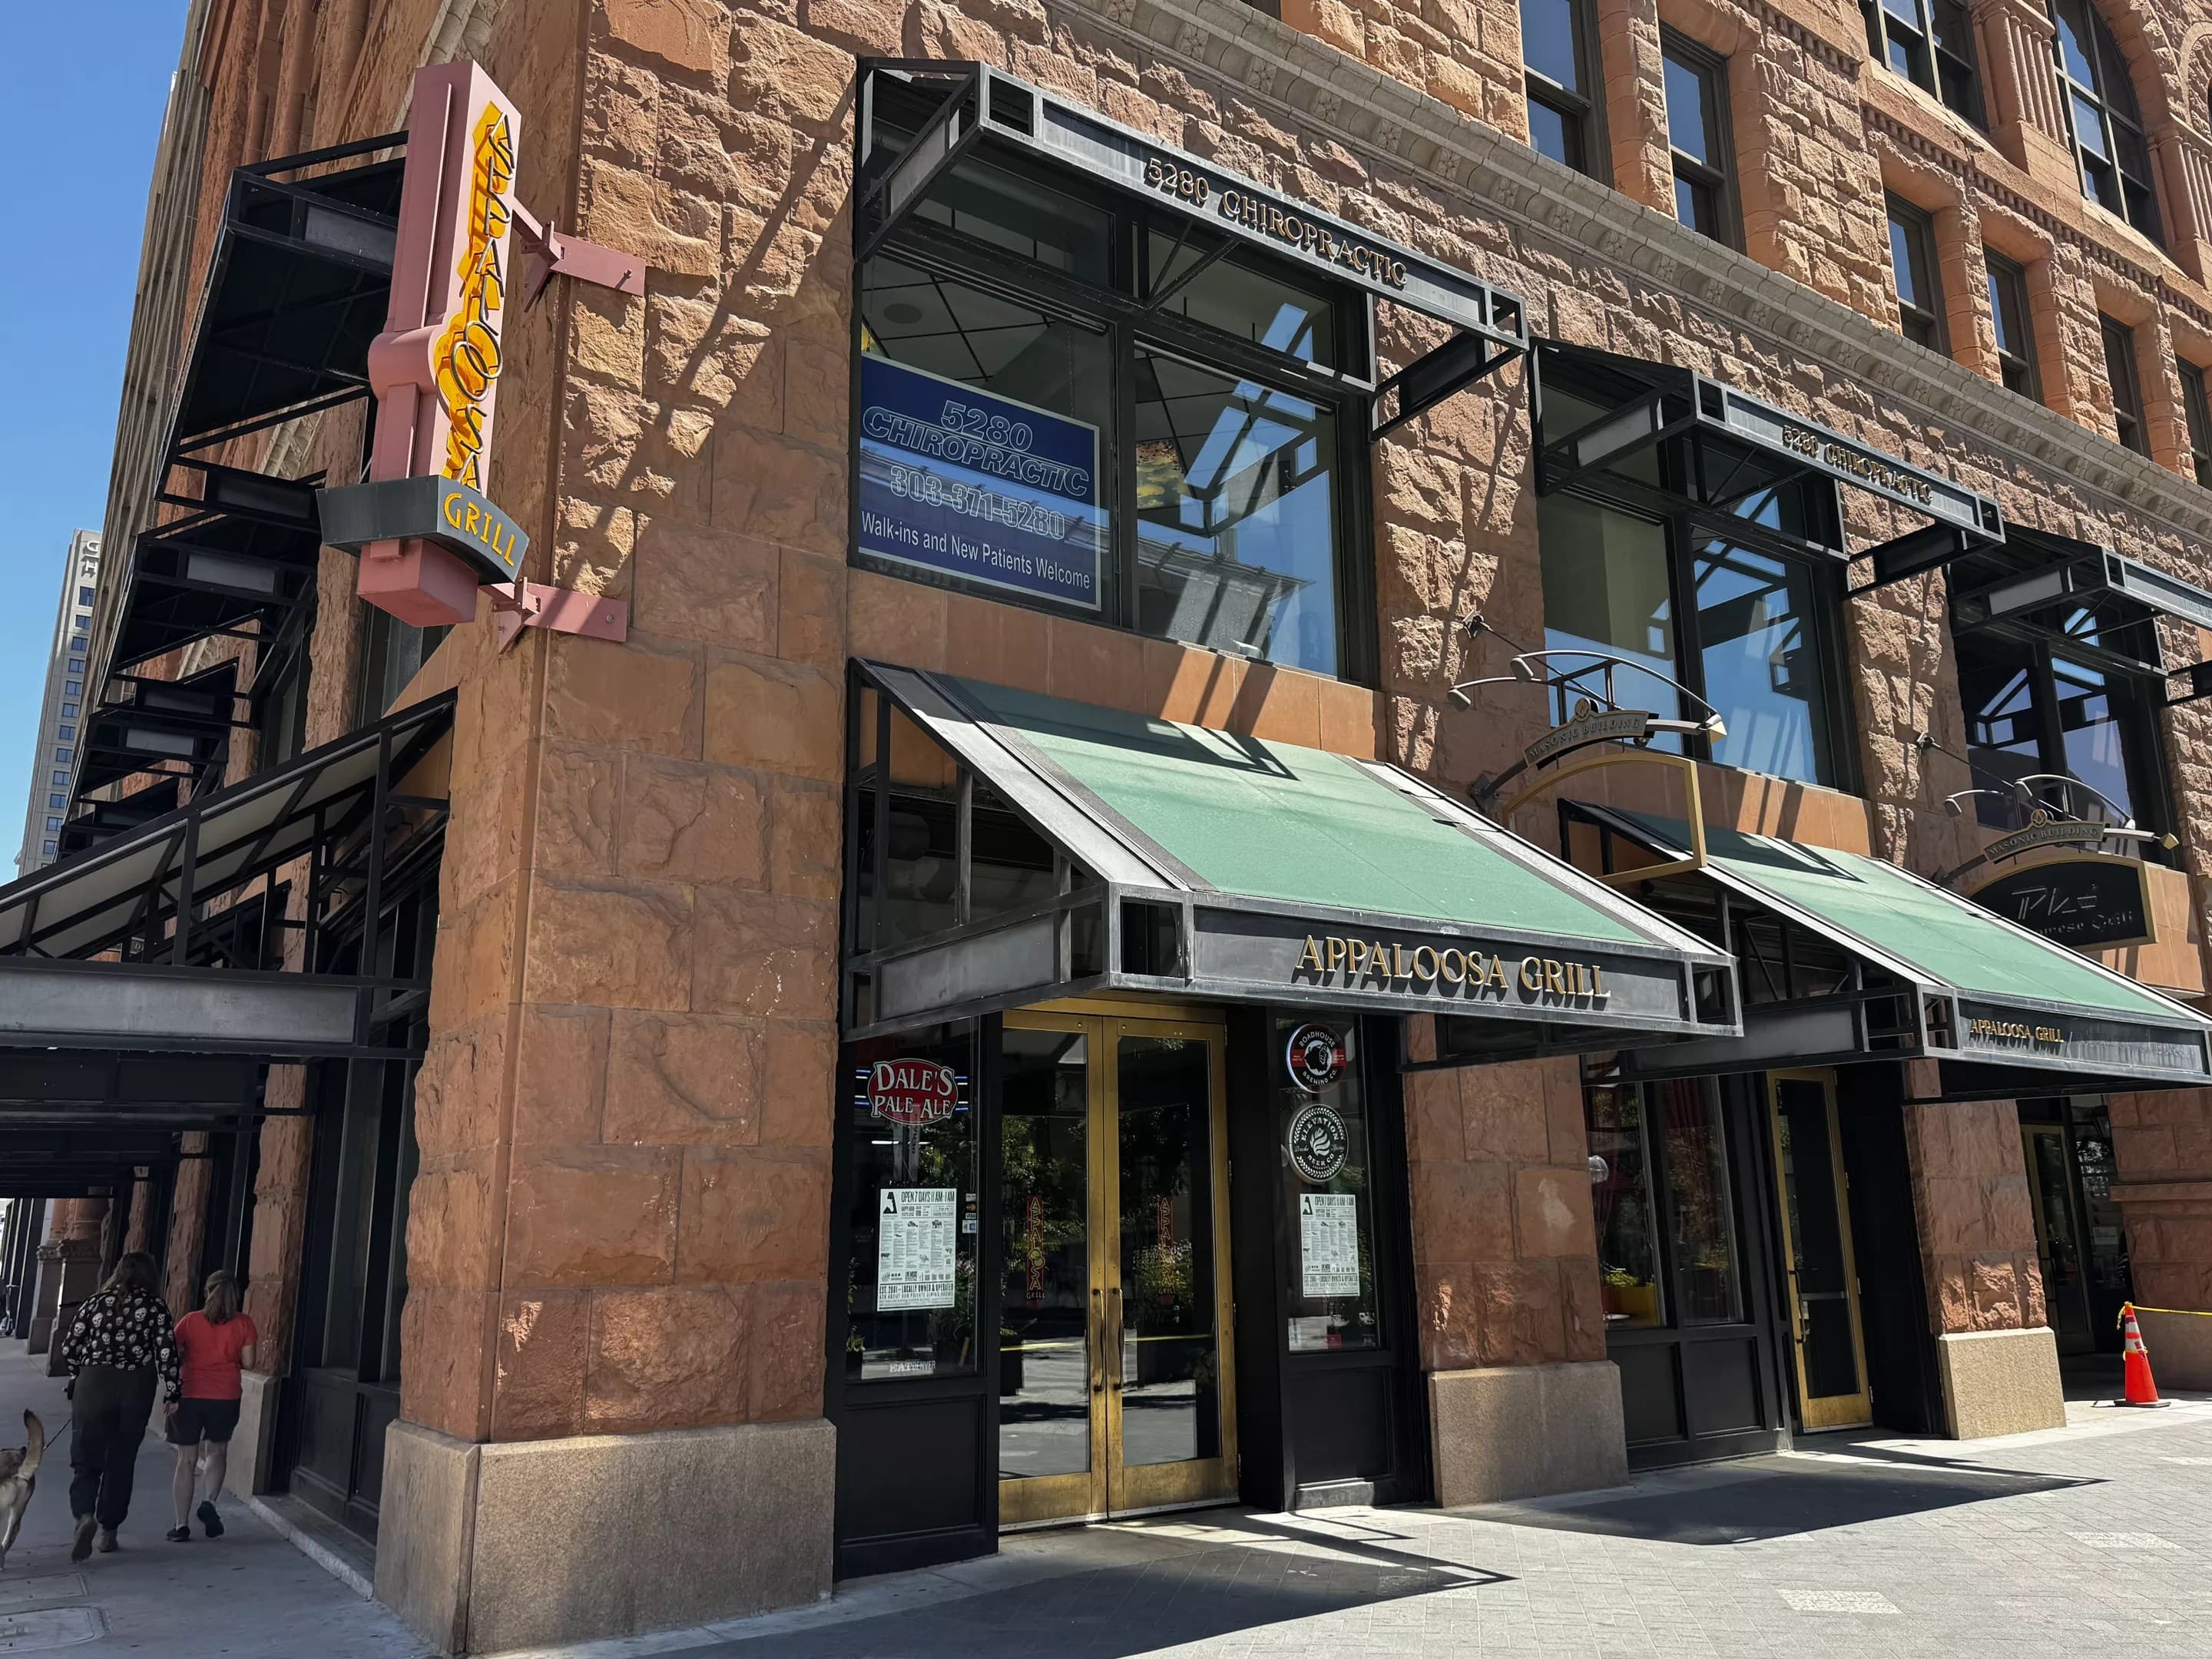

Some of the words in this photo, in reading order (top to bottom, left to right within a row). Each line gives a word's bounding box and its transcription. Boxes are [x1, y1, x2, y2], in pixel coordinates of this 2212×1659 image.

[1147, 157, 1210, 205] 5280
[1222, 189, 1408, 287] CHIROPRACTIC
[435, 101, 513, 493] APPALOOSA
[863, 406, 1089, 497] CHIROPRACTIC
[941, 400, 1033, 452] 5280
[1783, 424, 1820, 456] 5280
[1824, 443, 1933, 503] CHIROPRACTIC
[890, 465, 1065, 540] 303-371-5280
[444, 492, 515, 567] GRILL
[862, 511, 919, 545] Walk-ins
[922, 533, 947, 553] and
[952, 536, 979, 561] New
[982, 543, 1032, 575] Patients
[1035, 557, 1090, 589] Welcome
[1529, 729, 1580, 757] MASONIC
[1583, 718, 1641, 734] BUILDING
[1988, 833, 2036, 856] MASONIC
[2041, 827, 2098, 839] BUILDING
[1296, 934, 1508, 989] APPALOOSA
[1520, 956, 1611, 997] GRILL
[1299, 1030, 1336, 1048] ROADHOUSE
[1969, 1018, 2032, 1038] APPALOOSA
[2035, 1026, 2065, 1043] GRILL
[1302, 1071, 1329, 1084] BREWING
[874, 1095, 914, 1115] PALE
[920, 1098, 952, 1119] ALE
[1301, 1117, 1339, 1141] ELEVATION
[1307, 1154, 1326, 1166] BEER
[919, 1191, 931, 1203] DAYS
[1028, 1197, 1045, 1290] APPALOOSA
